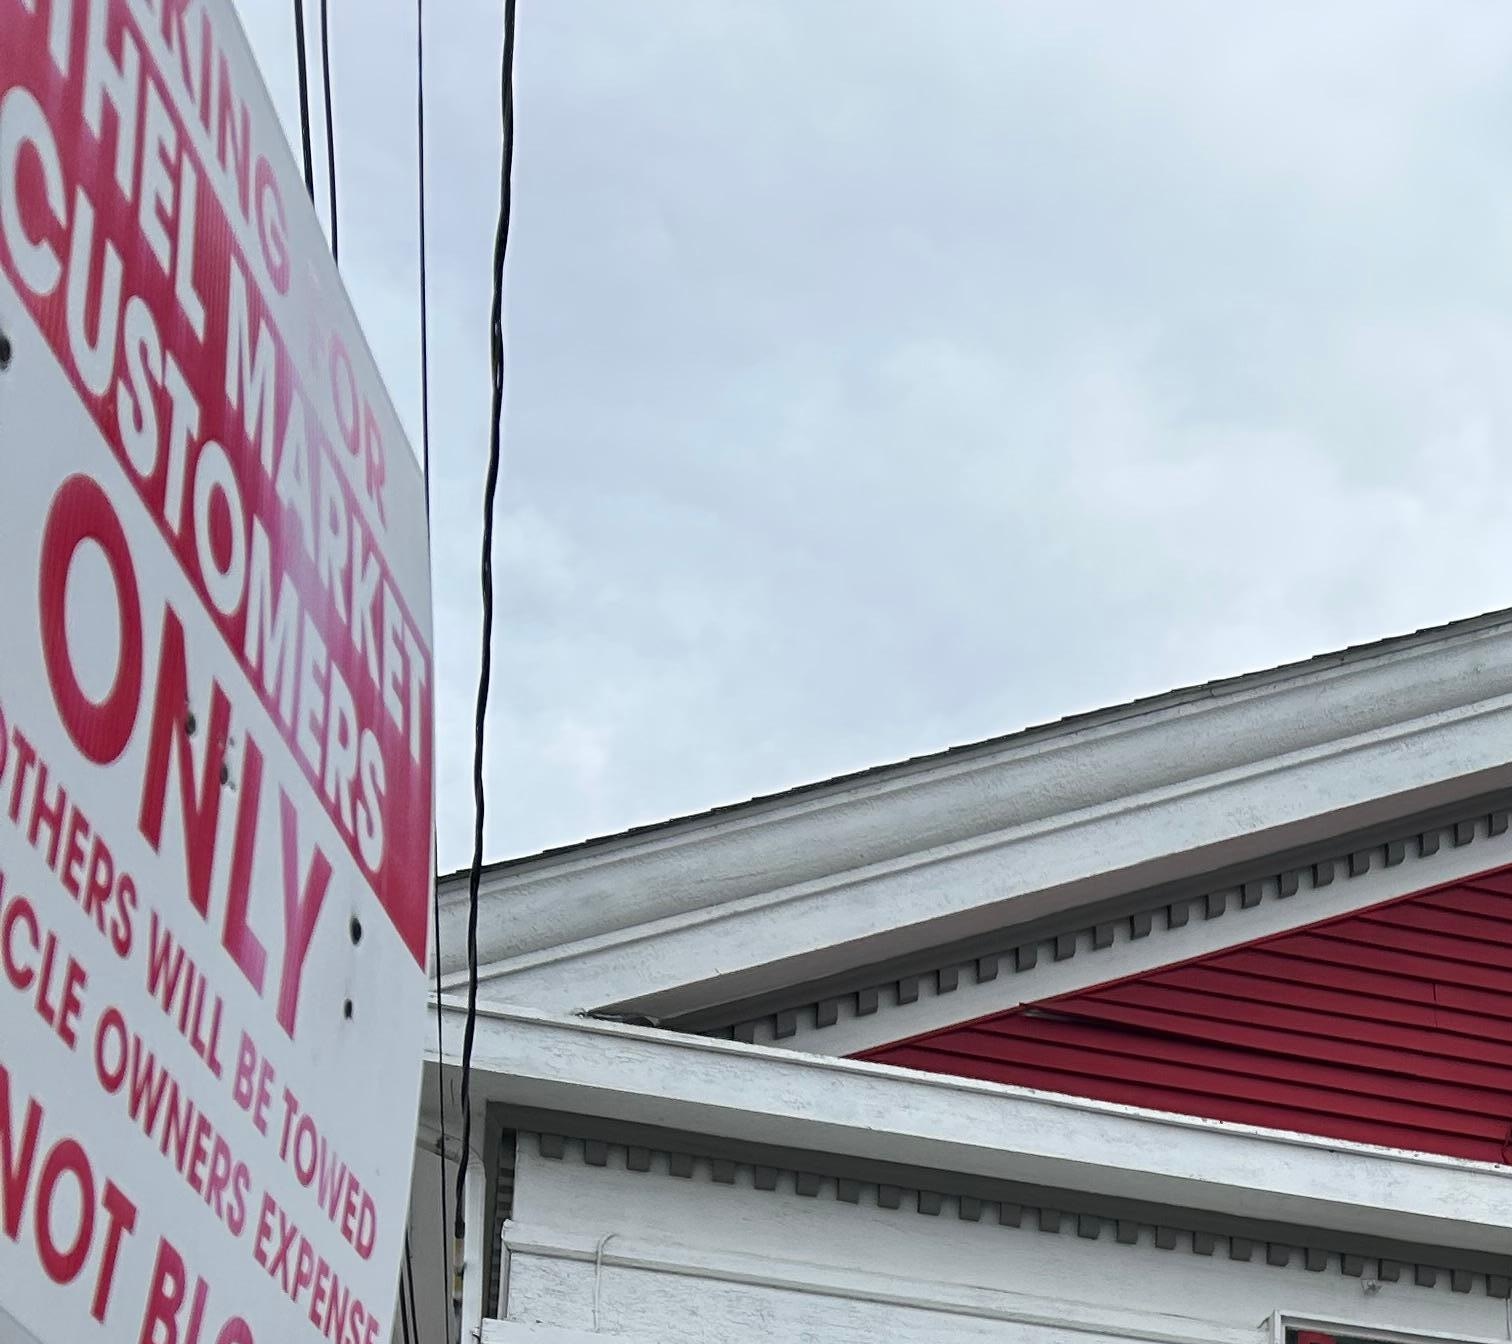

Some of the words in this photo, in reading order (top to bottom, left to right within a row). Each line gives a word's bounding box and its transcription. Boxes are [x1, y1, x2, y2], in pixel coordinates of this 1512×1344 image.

[0, 85, 387, 872] CUSTOMERS
[147, 0, 290, 296] KING
[314, 292, 387, 534] OR
[225, 254, 426, 766] MARKET
[0, 705, 138, 959] THERS
[147, 906, 224, 1079] WILL
[231, 1028, 273, 1137] BE
[279, 1080, 378, 1261] TOWED
[38, 472, 333, 1040] ONLY
[0, 866, 88, 1050] CLE
[95, 1005, 251, 1238] OWNERS
[0, 1060, 138, 1325] NOT
